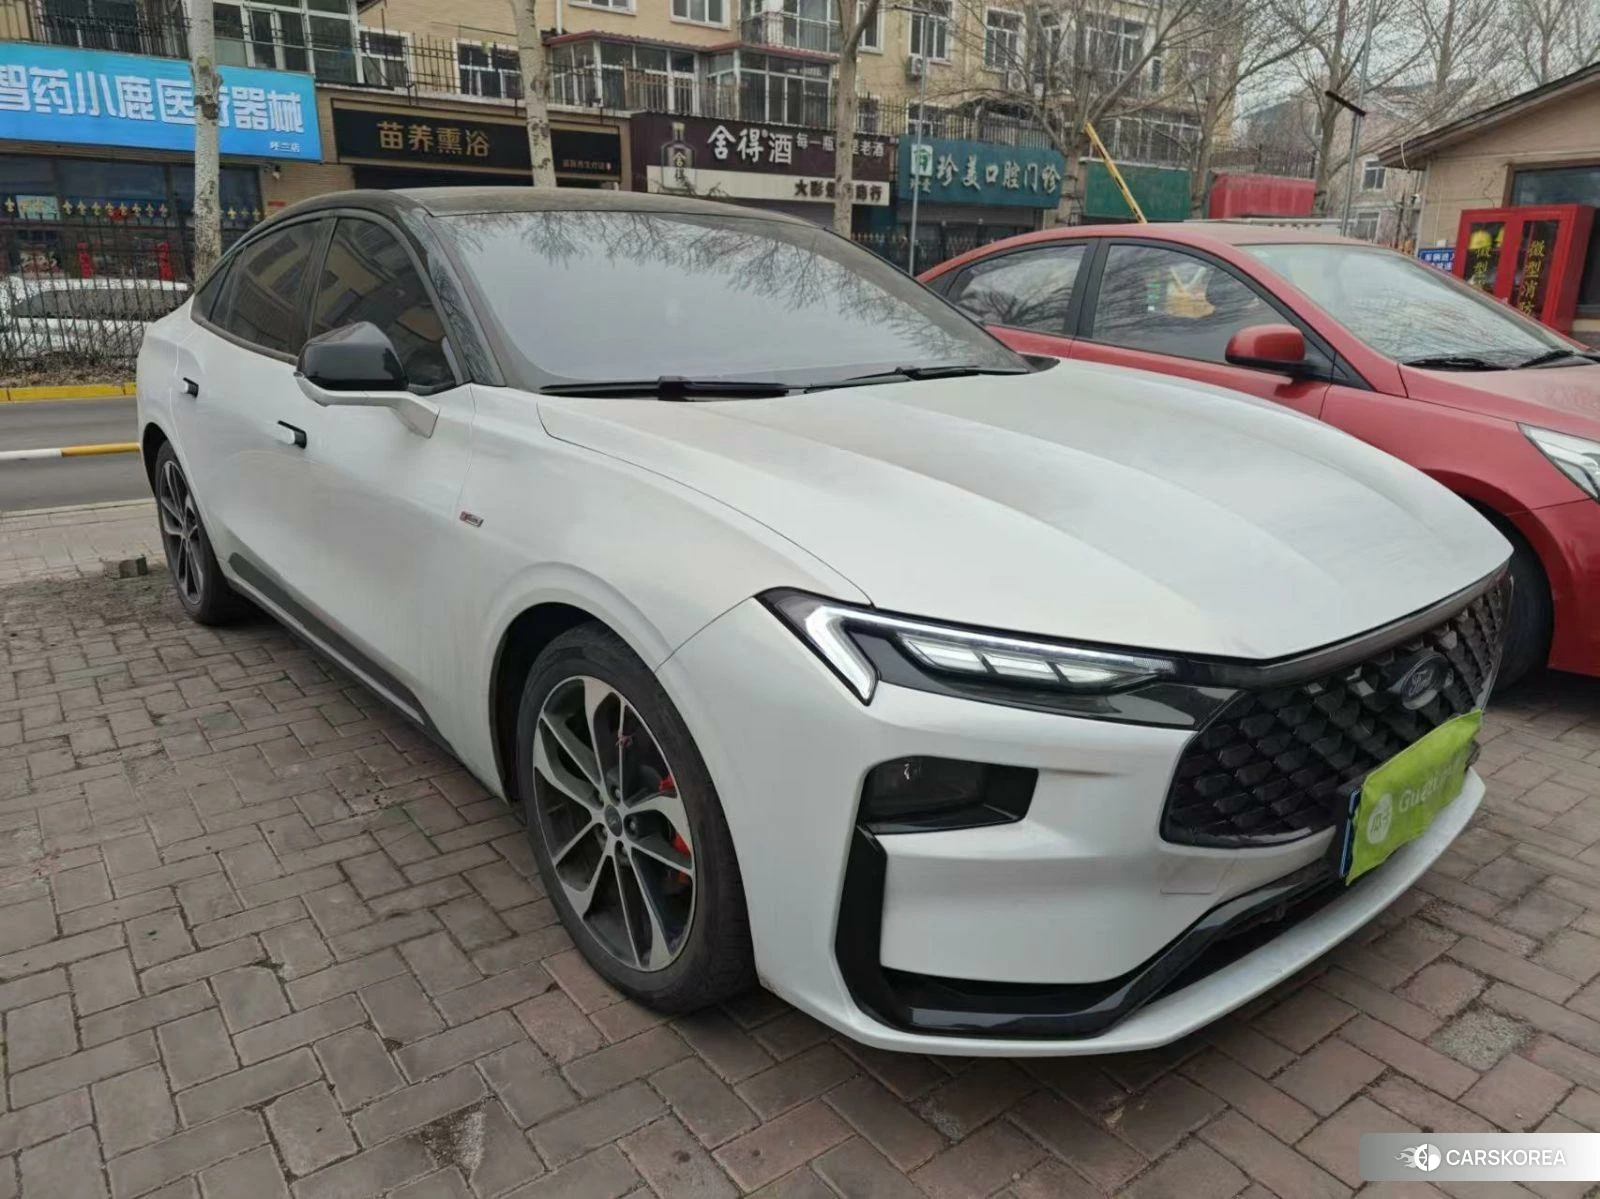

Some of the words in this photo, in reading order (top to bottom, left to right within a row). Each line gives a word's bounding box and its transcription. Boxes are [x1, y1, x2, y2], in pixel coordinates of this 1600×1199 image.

[377, 120, 489, 157] 苗养熏浴
[796, 132, 885, 158] 每一瓶是老酒
[937, 153, 1061, 194] 珍美口腔门诊
